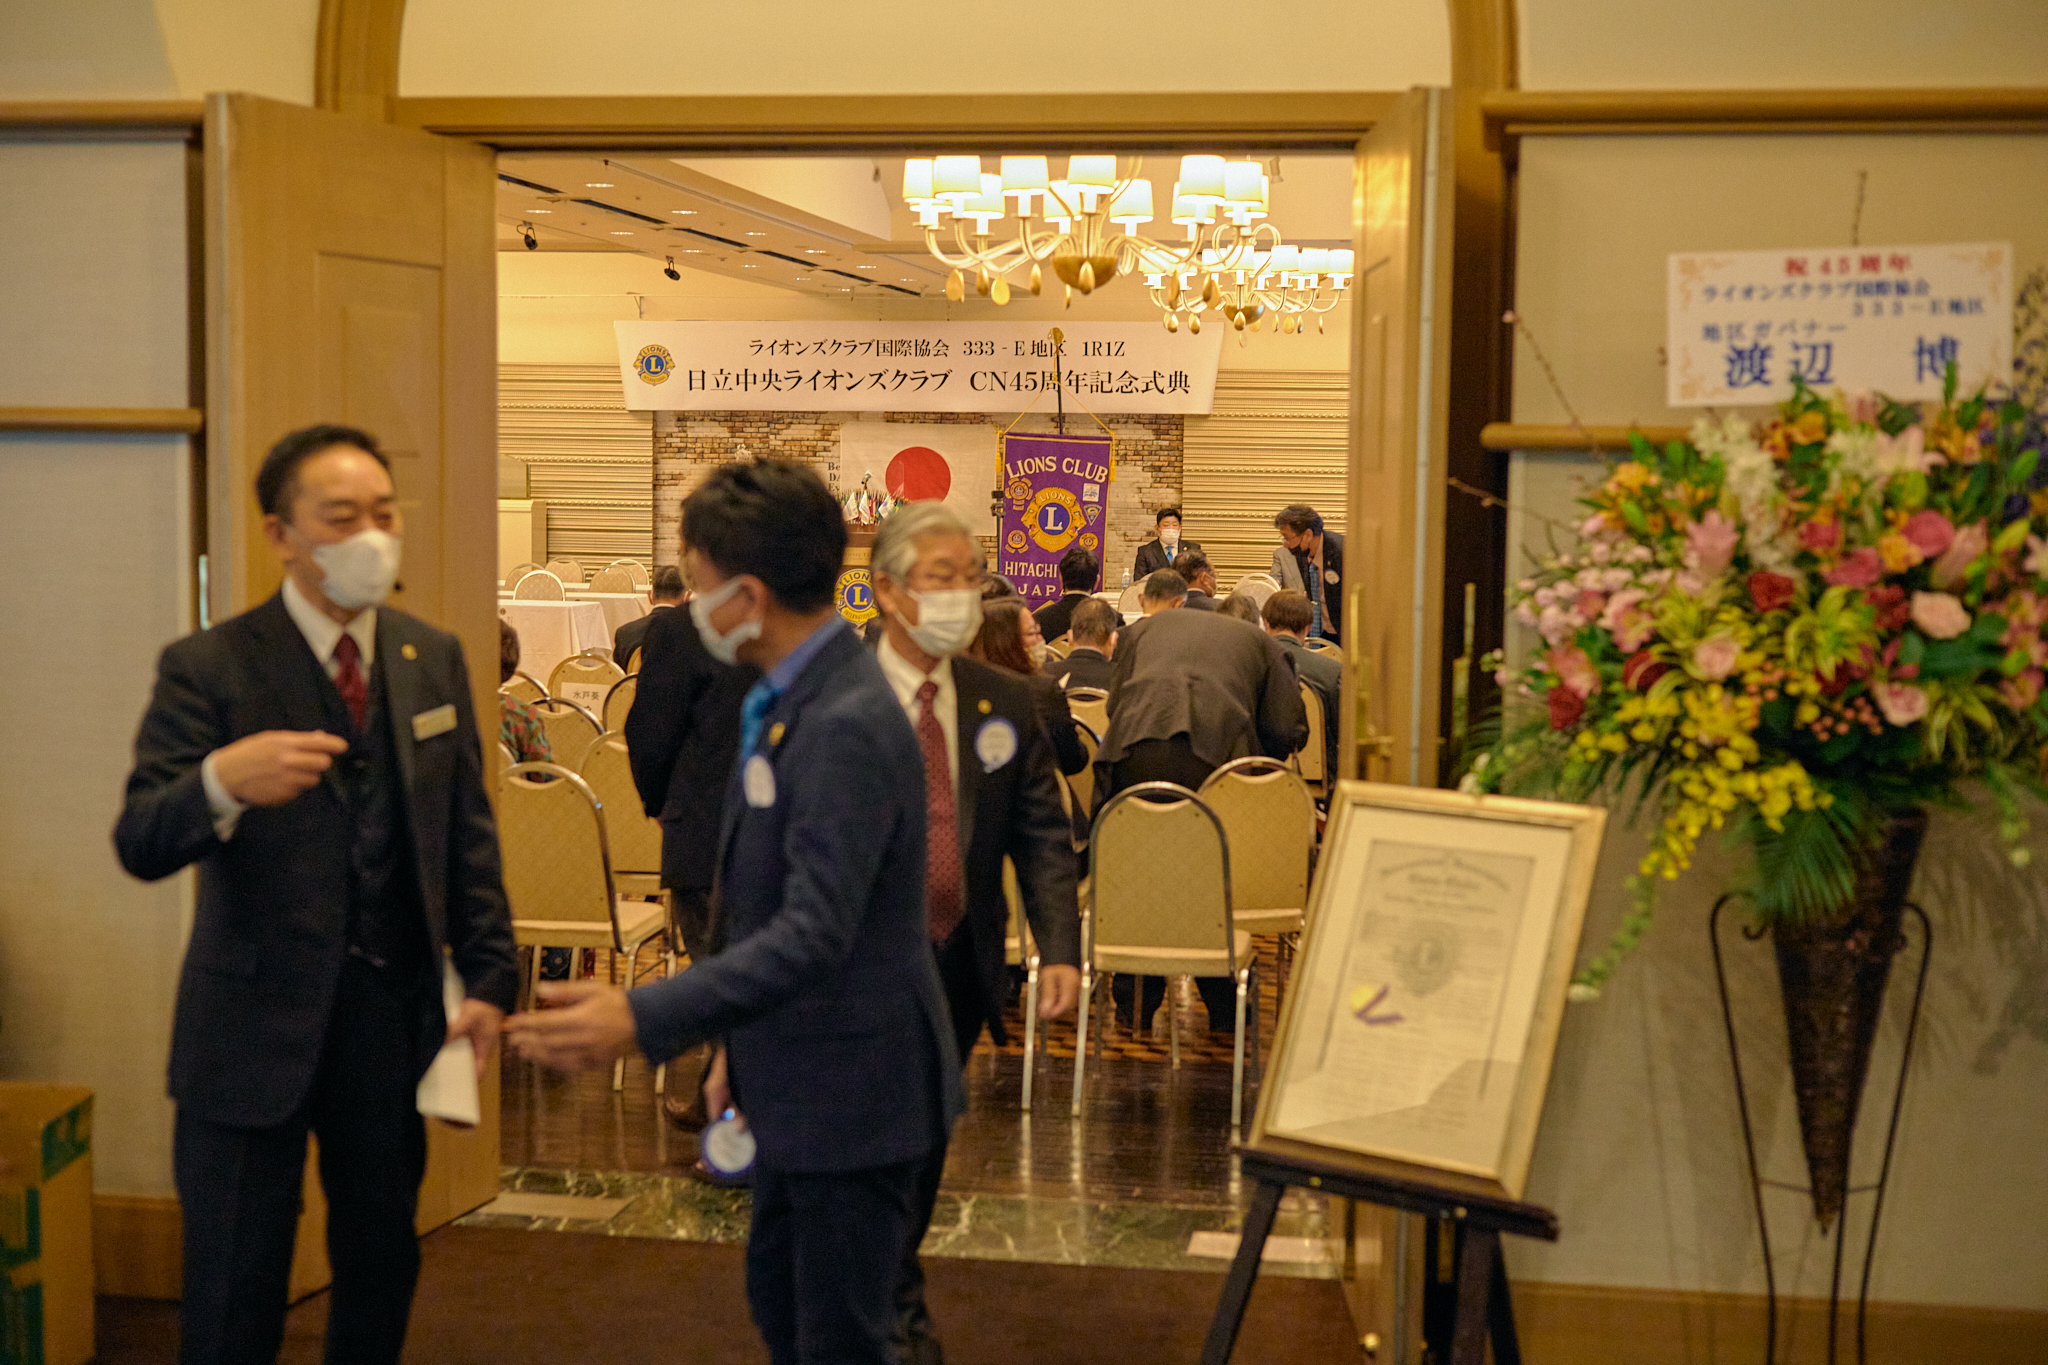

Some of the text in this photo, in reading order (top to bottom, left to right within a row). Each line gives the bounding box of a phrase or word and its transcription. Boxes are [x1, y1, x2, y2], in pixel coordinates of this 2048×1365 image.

[641, 346, 668, 355] LIONS
[749, 339, 950, 358] ライオンズクラブ国際協会
[1082, 340, 1126, 358] 1R1Z
[649, 357, 661, 372] L
[688, 368, 1191, 395] 日立中央ライオンズクラブ CN45周年記念式典
[1005, 455, 1108, 483] LIONS CLUB
[1039, 490, 1072, 505] LIONS
[1044, 506, 1063, 531] L
[843, 572, 870, 584] LION
[1004, 561, 1058, 578] HITACHI
[852, 586, 868, 606] L
